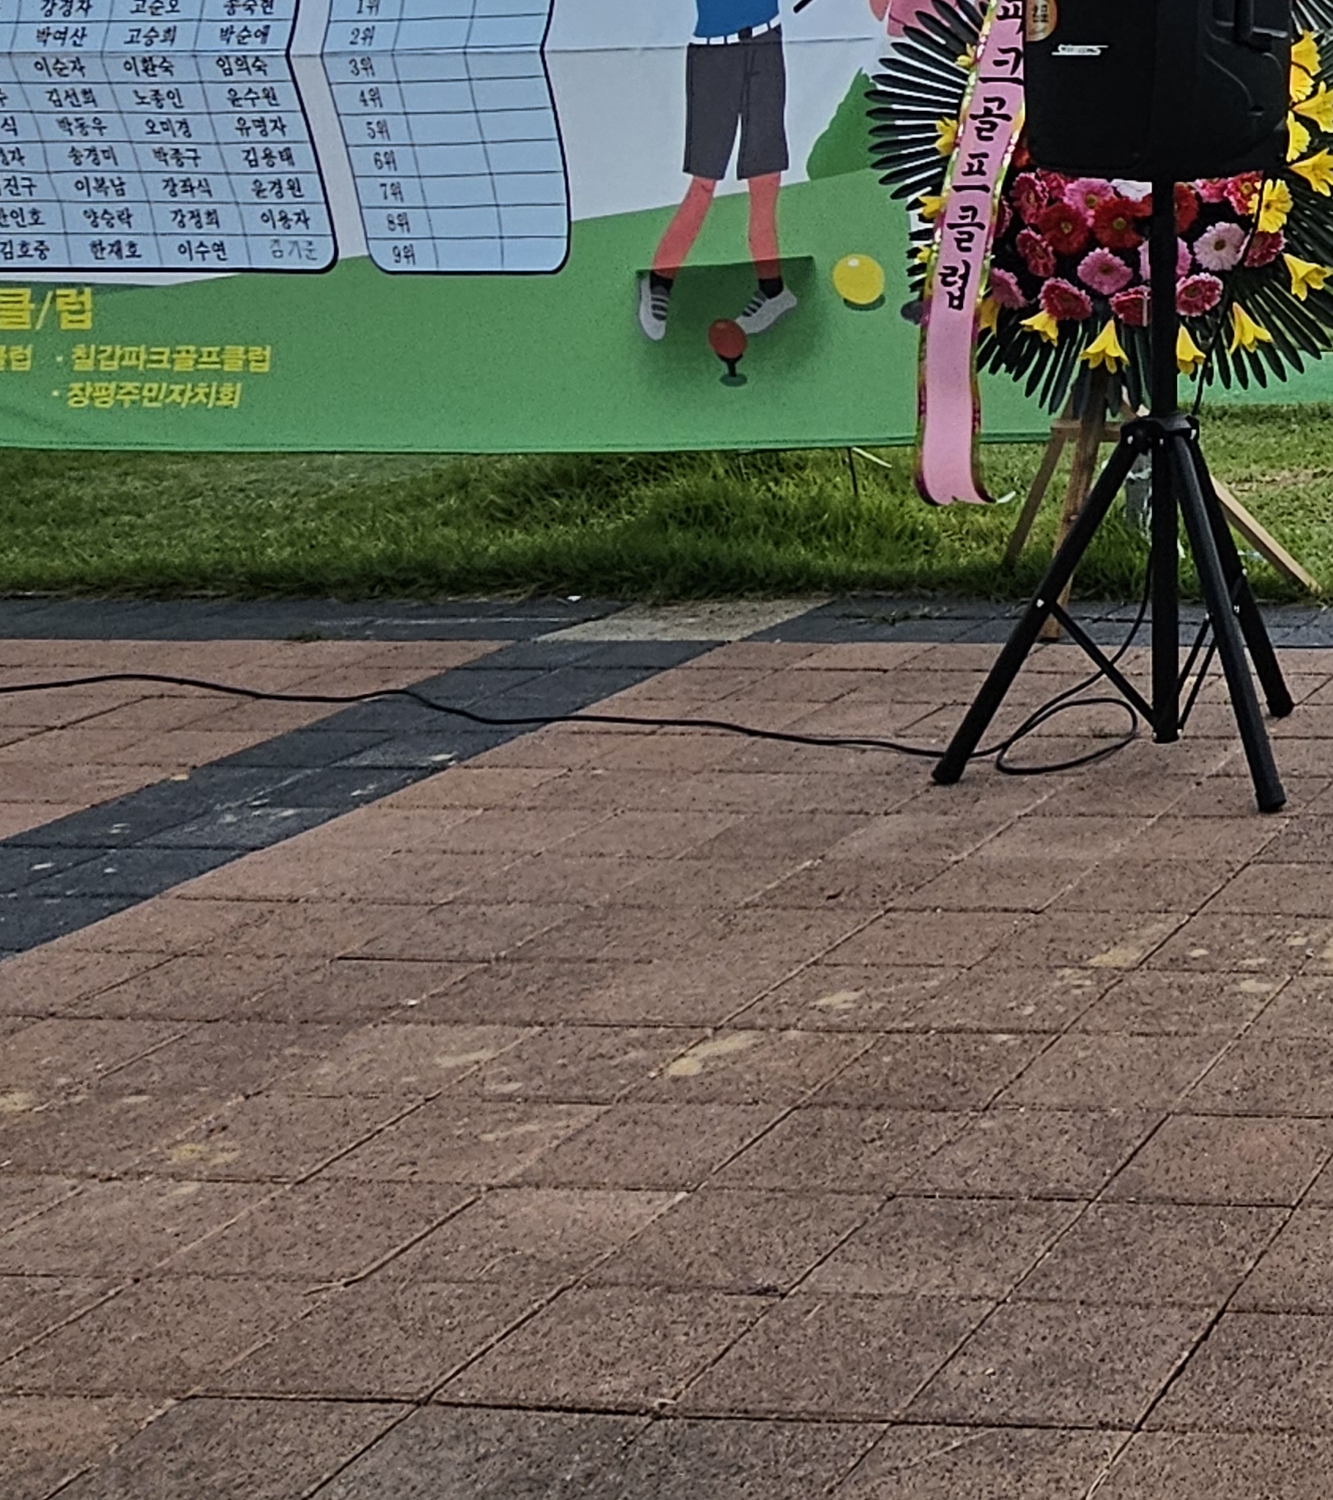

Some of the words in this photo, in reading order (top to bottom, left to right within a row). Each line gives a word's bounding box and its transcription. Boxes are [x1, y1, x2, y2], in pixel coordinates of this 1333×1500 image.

[37, 27, 87, 47] 박여산
[220, 25, 270, 45] 박순애
[350, 26, 375, 45] 2위
[34, 57, 85, 77] 이순자
[216, 55, 270, 76] 임의숙
[349, 56, 375, 76] 3위
[360, 88, 383, 107] 4위
[56, 117, 107, 136] 박동우
[146, 118, 192, 138] 오미경
[235, 116, 286, 137] 유명자
[366, 120, 390, 140] 5위
[69, 146, 118, 166] 송경미
[242, 147, 295, 168] 김용태
[374, 151, 397, 170] 6위
[75, 176, 125, 197] 이복남
[380, 182, 403, 202] 7위
[84, 208, 132, 228] 양승락
[261, 209, 310, 229] 이용자
[388, 213, 410, 232] 8위
[90, 240, 141, 260] 한재호
[178, 240, 227, 261] 이수연
[393, 244, 415, 264] 9위
[0, 345, 32, 371] 럽
[67, 382, 242, 408] 장평주민자치회
